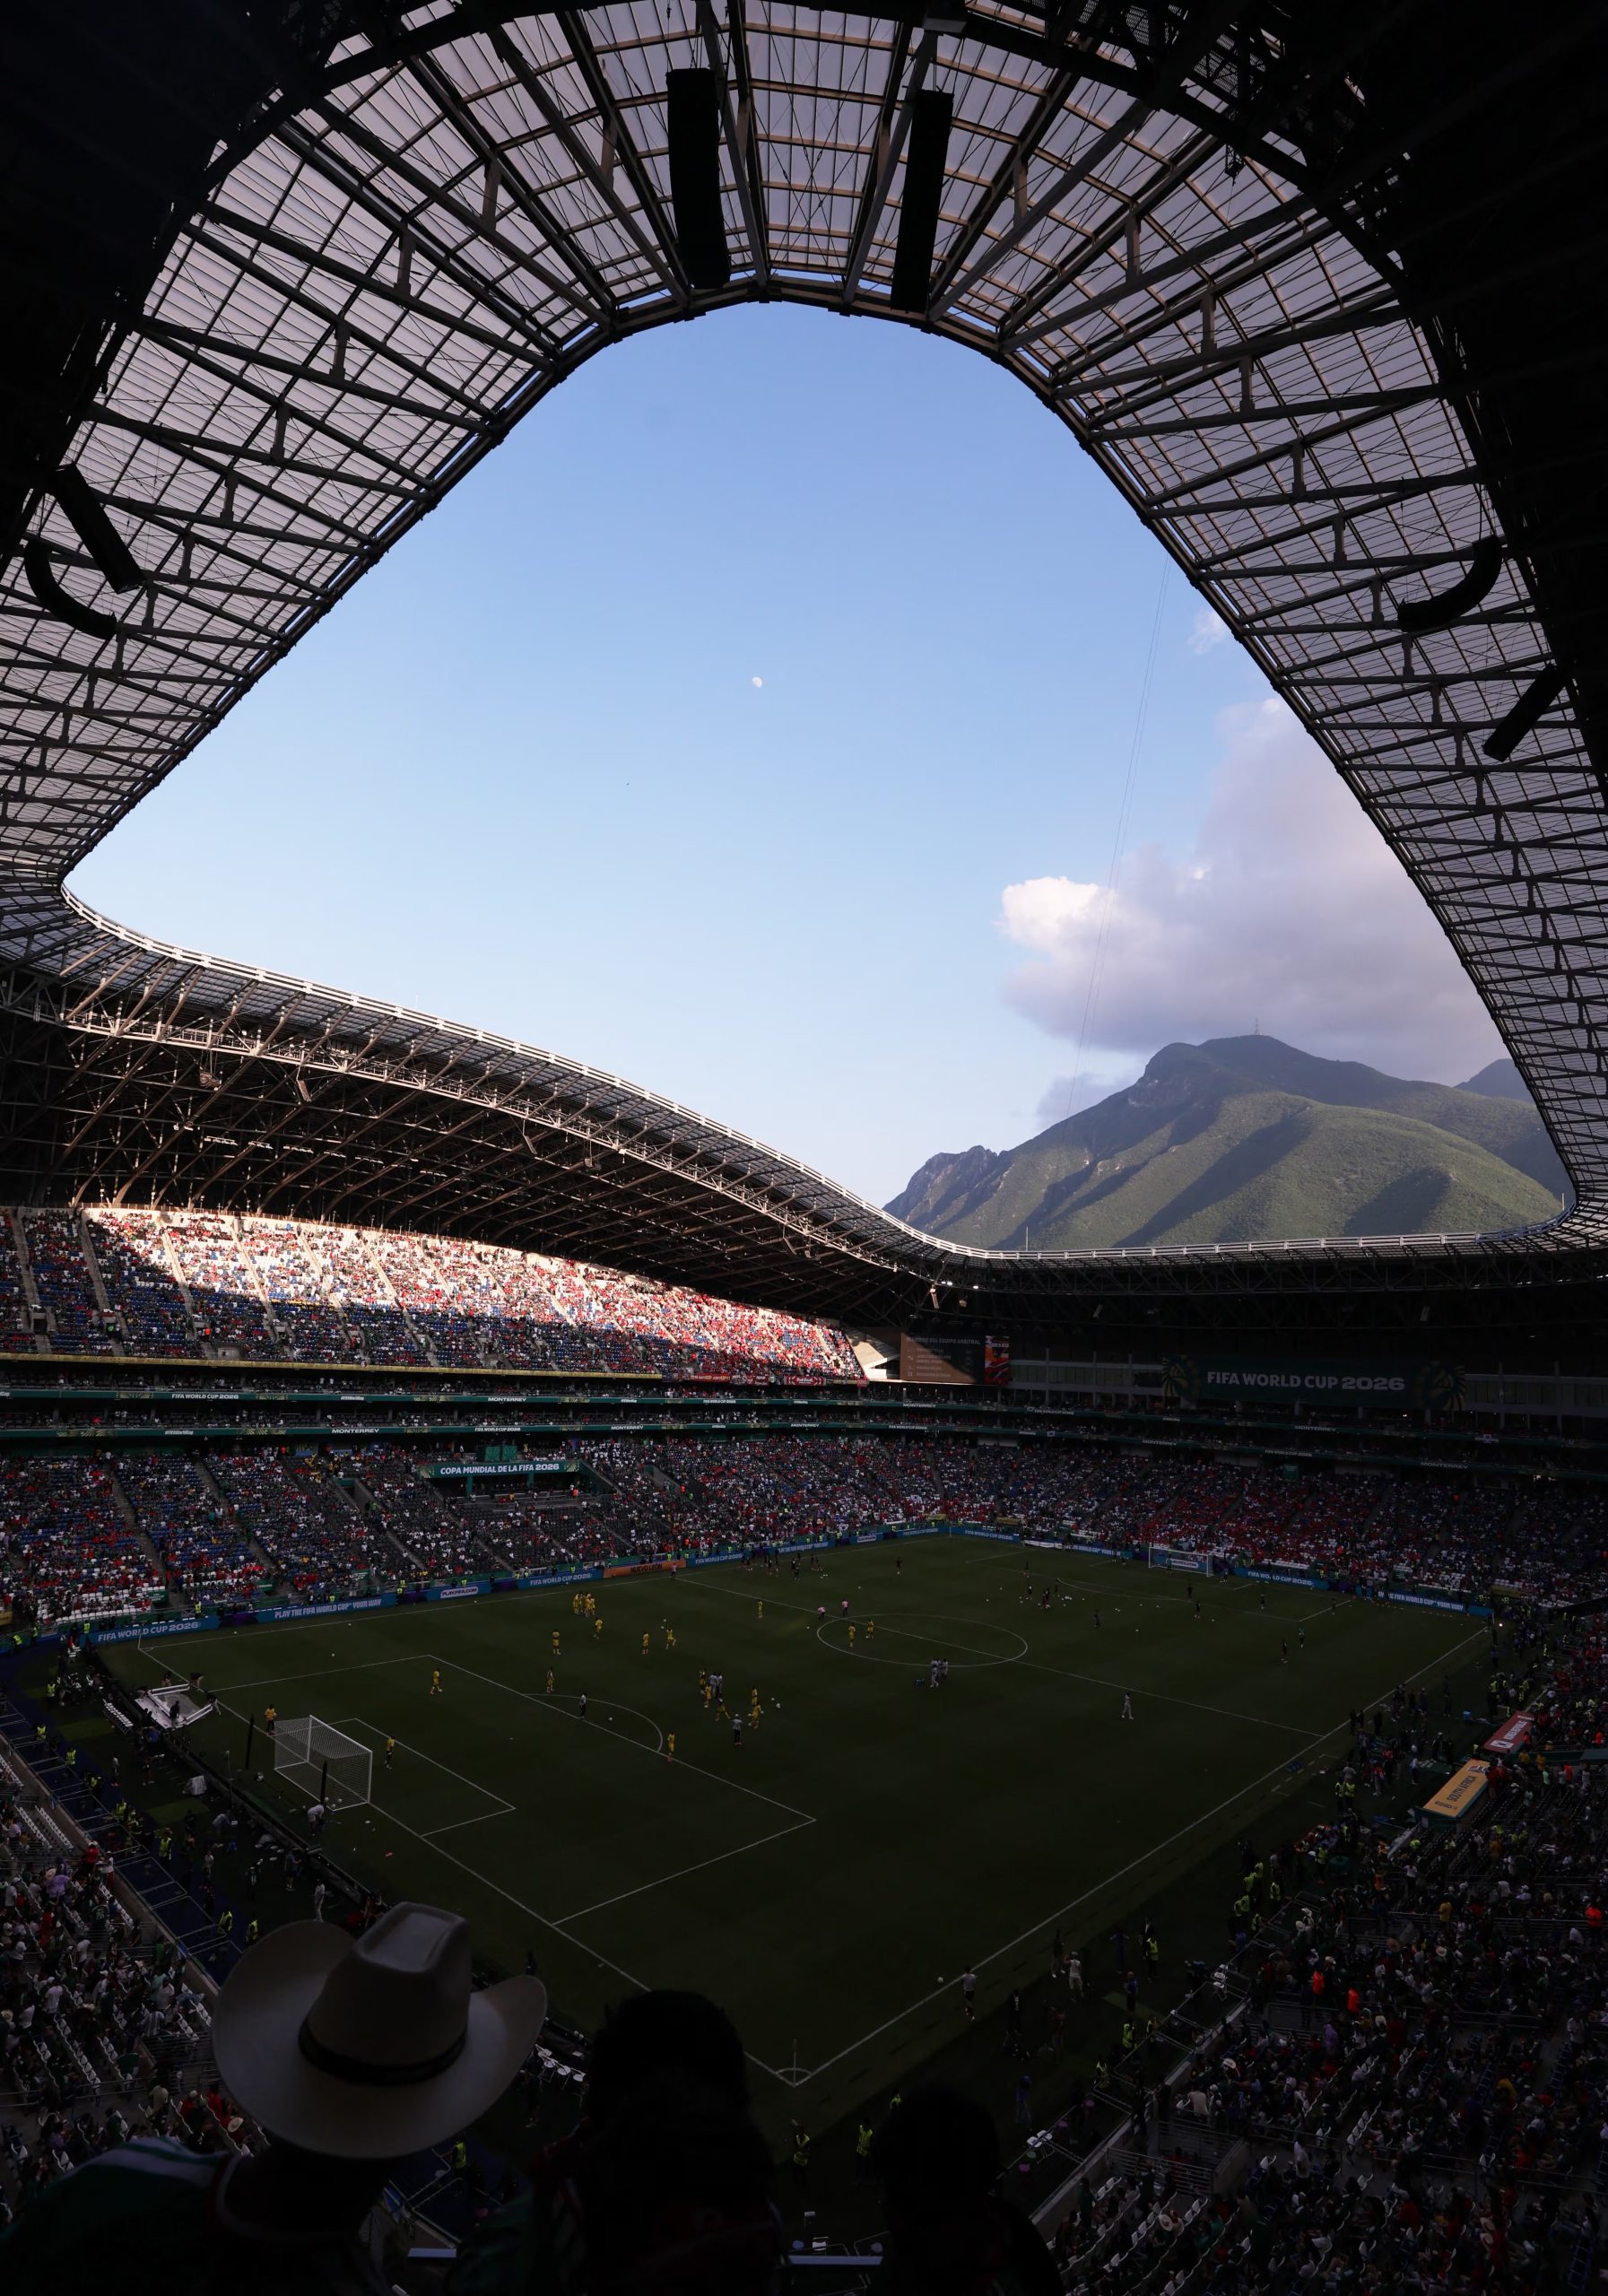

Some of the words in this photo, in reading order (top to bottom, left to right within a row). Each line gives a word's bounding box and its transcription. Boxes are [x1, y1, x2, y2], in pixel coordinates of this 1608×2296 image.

[1206, 1371, 1240, 1385] FIFA
[1242, 1373, 1301, 1387] WORLD
[1304, 1375, 1338, 1389] CUP
[1341, 1377, 1405, 1390] 2026
[439, 1466, 462, 1474] COPA
[463, 1465, 497, 1474] MUNDIAL
[498, 1465, 508, 1473] DE
[508, 1465, 518, 1473] LA
[518, 1464, 535, 1472] FIFA
[535, 1463, 560, 1471] 2026
[530, 1578, 543, 1586] FIFA
[543, 1576, 562, 1585] WORLD
[562, 1575, 573, 1583] CUP
[573, 1573, 591, 1581] 2026
[1260, 1572, 1280, 1581] WOLD
[1405, 1595, 1424, 1605] WORLD
[274, 1610, 291, 1618] PLAY
[291, 1608, 302, 1616] THE
[302, 1606, 316, 1615] FIFA
[316, 1605, 337, 1613] WORLD
[352, 1601, 368, 1609] YOUR
[368, 1599, 382, 1607] WAY
[98, 1632, 116, 1642] FIFA
[117, 1628, 149, 1639] WORLD
[150, 1625, 168, 1634] CUP
[169, 1622, 199, 1631] 2026
